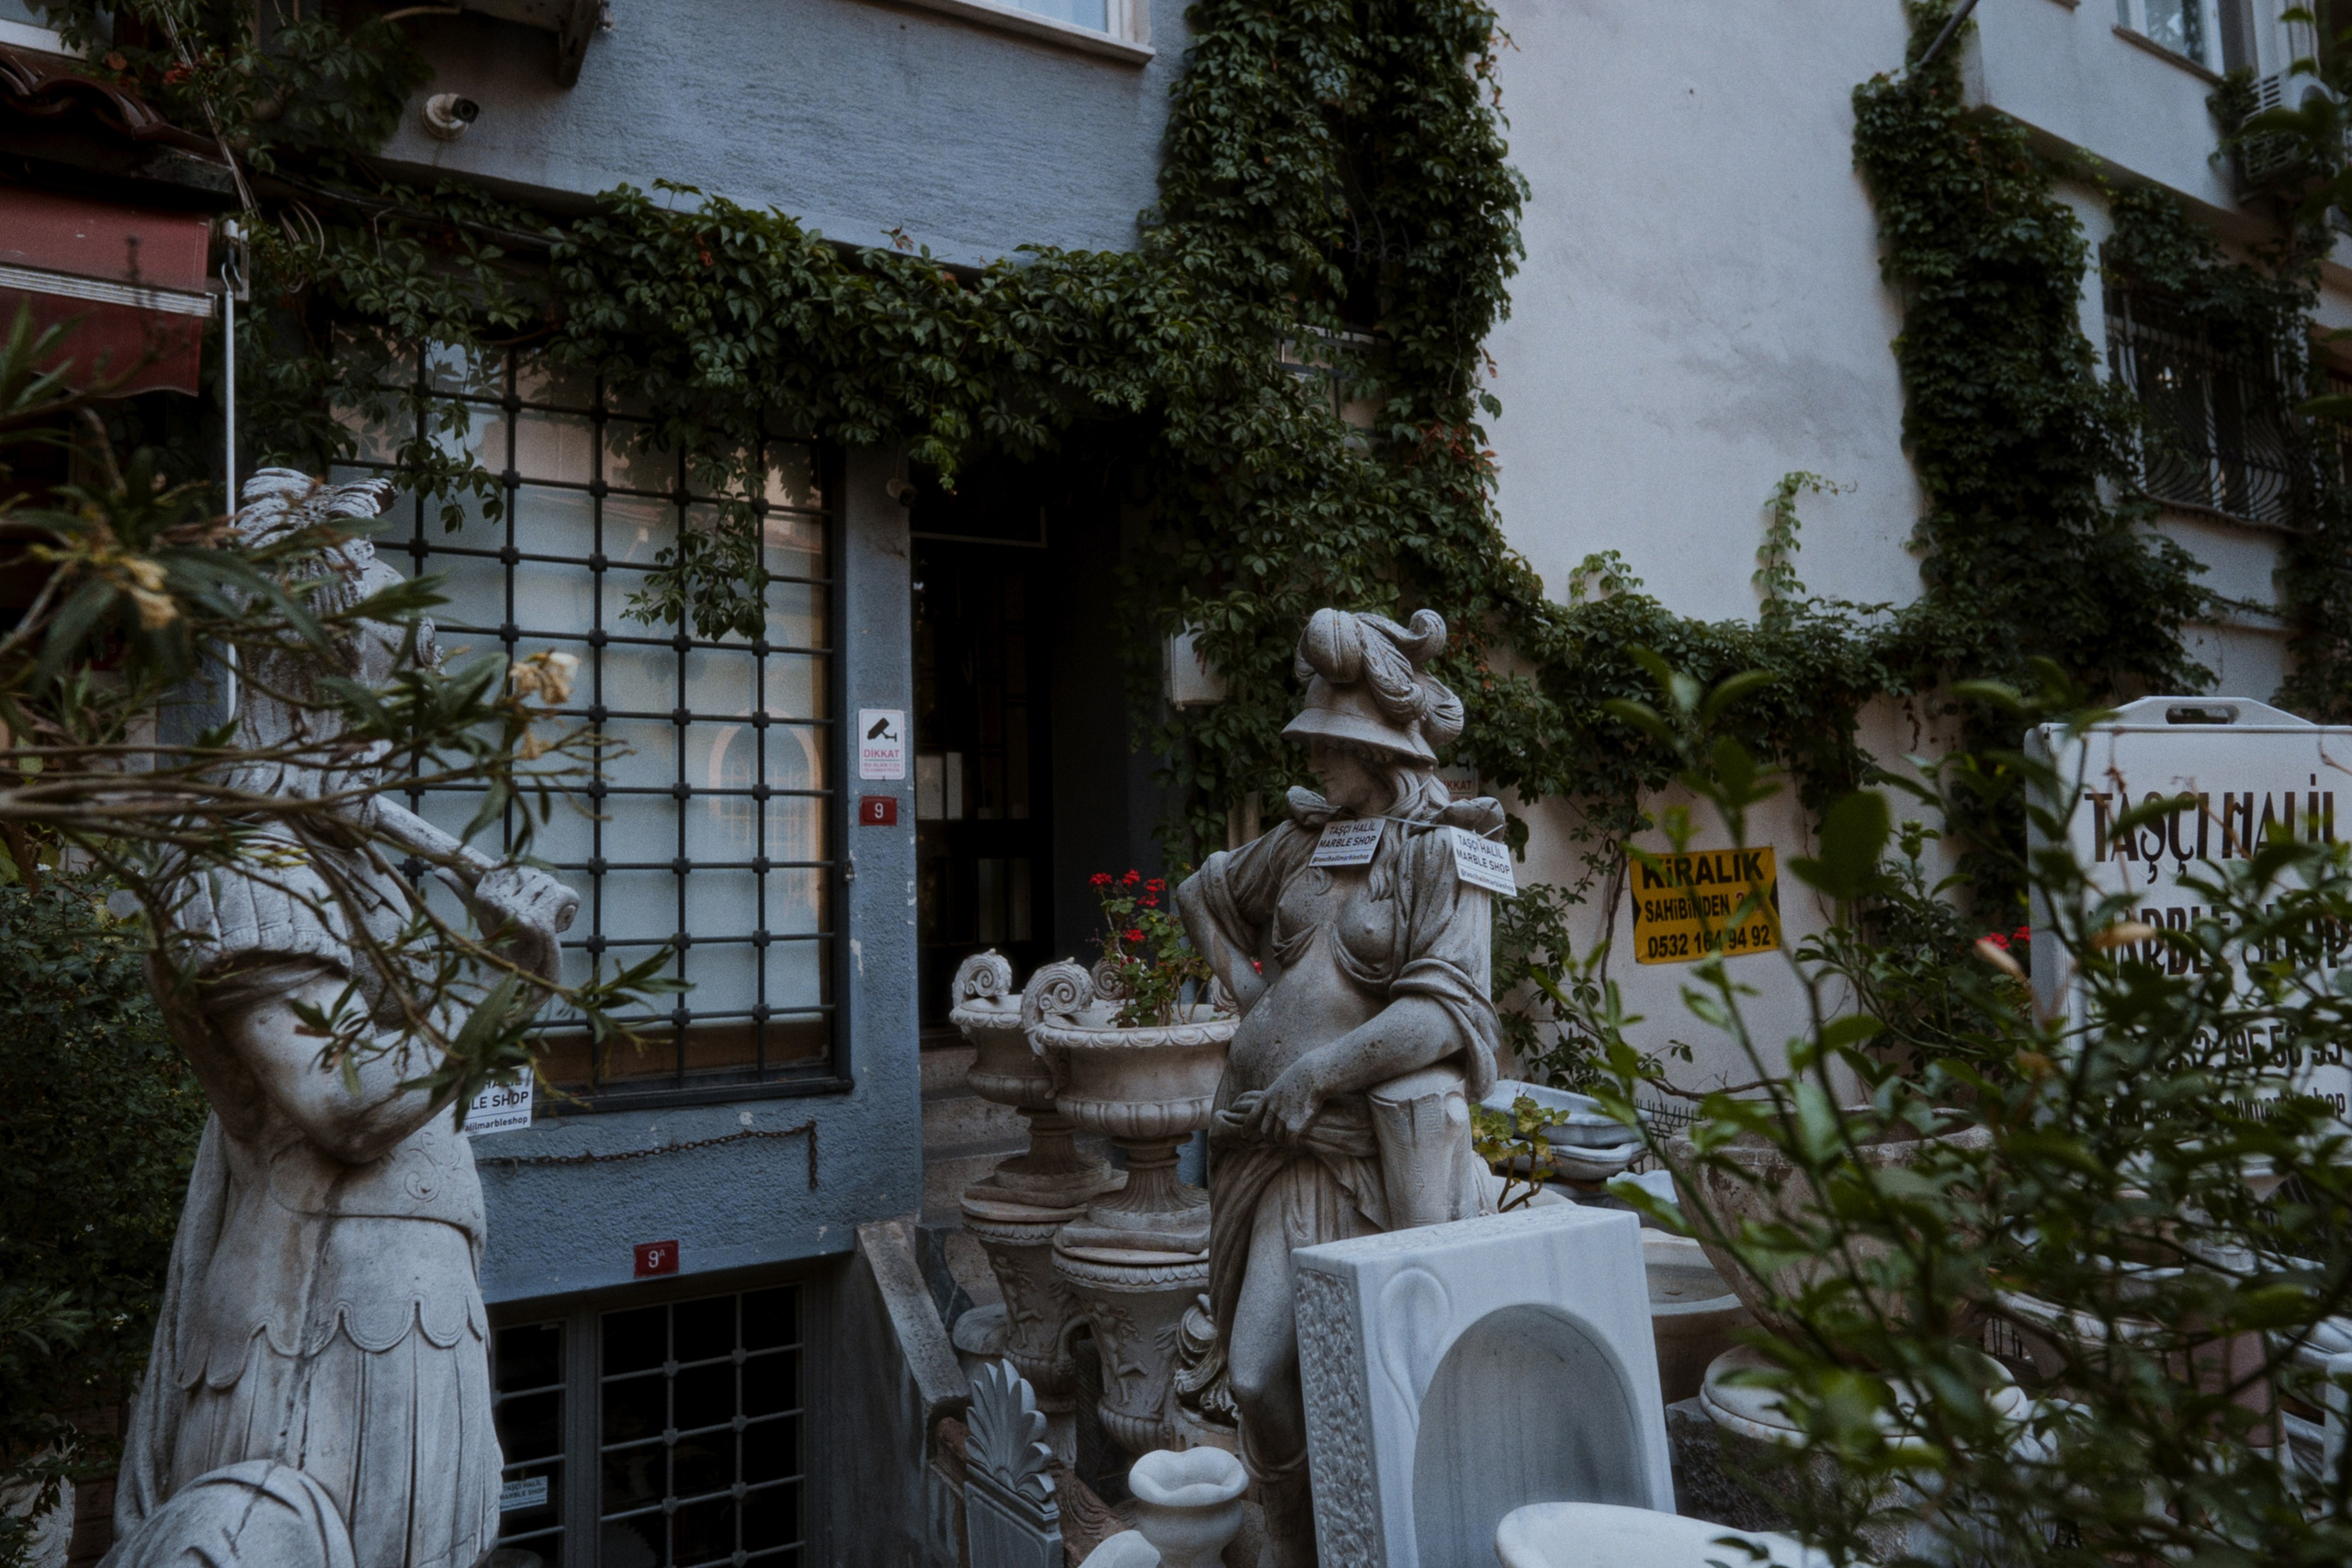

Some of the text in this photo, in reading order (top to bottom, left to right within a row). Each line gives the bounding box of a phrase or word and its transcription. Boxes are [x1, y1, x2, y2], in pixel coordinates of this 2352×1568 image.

[864, 748, 899, 758] DİKKAT
[874, 802, 884, 818] 9
[1318, 835, 1376, 848] MARBLE SHOP
[1479, 842, 1504, 859] HALİL
[1456, 848, 1510, 874] MARBLE SHOP
[1647, 932, 1689, 959] 0532
[1728, 927, 1747, 950] 94
[1751, 924, 1770, 947] 92
[492, 1091, 529, 1108] SHOP
